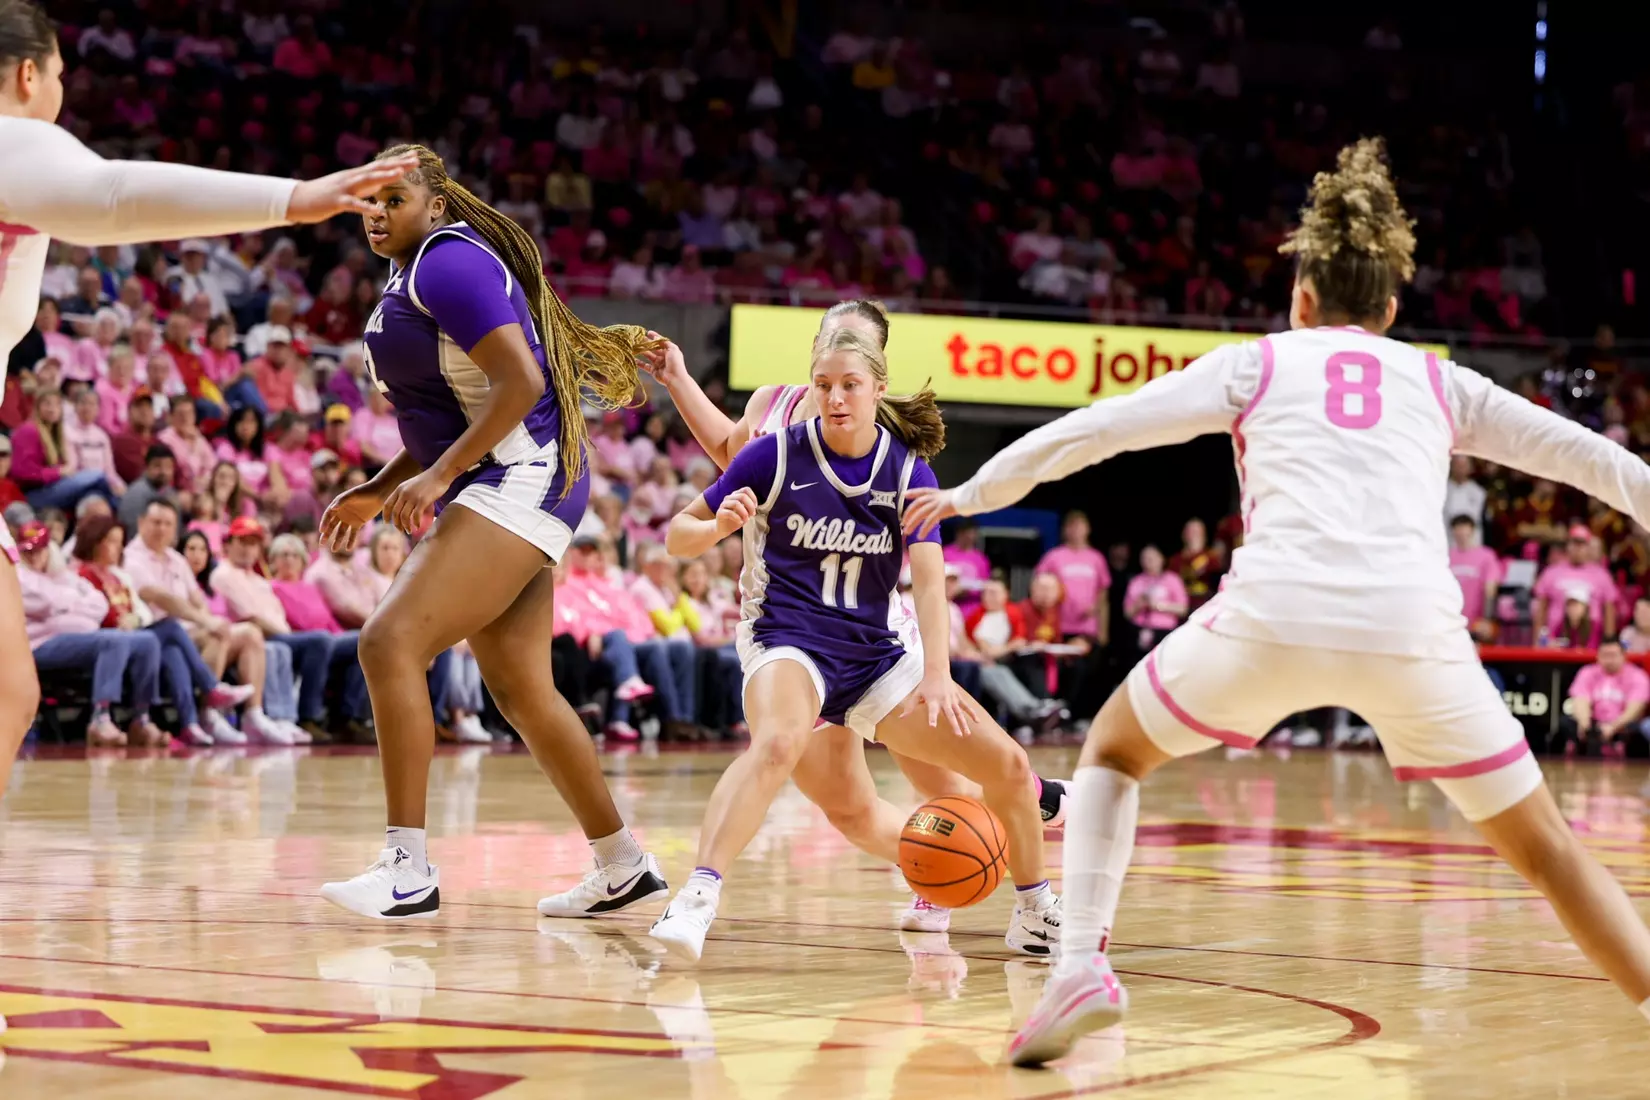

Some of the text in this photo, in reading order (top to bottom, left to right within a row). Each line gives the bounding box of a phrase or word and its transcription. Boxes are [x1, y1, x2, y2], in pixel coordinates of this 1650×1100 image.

[946, 333, 1078, 383] taco
[1324, 350, 1382, 430] 8
[786, 513, 894, 555] Wildcats
[819, 552, 864, 610] 11
